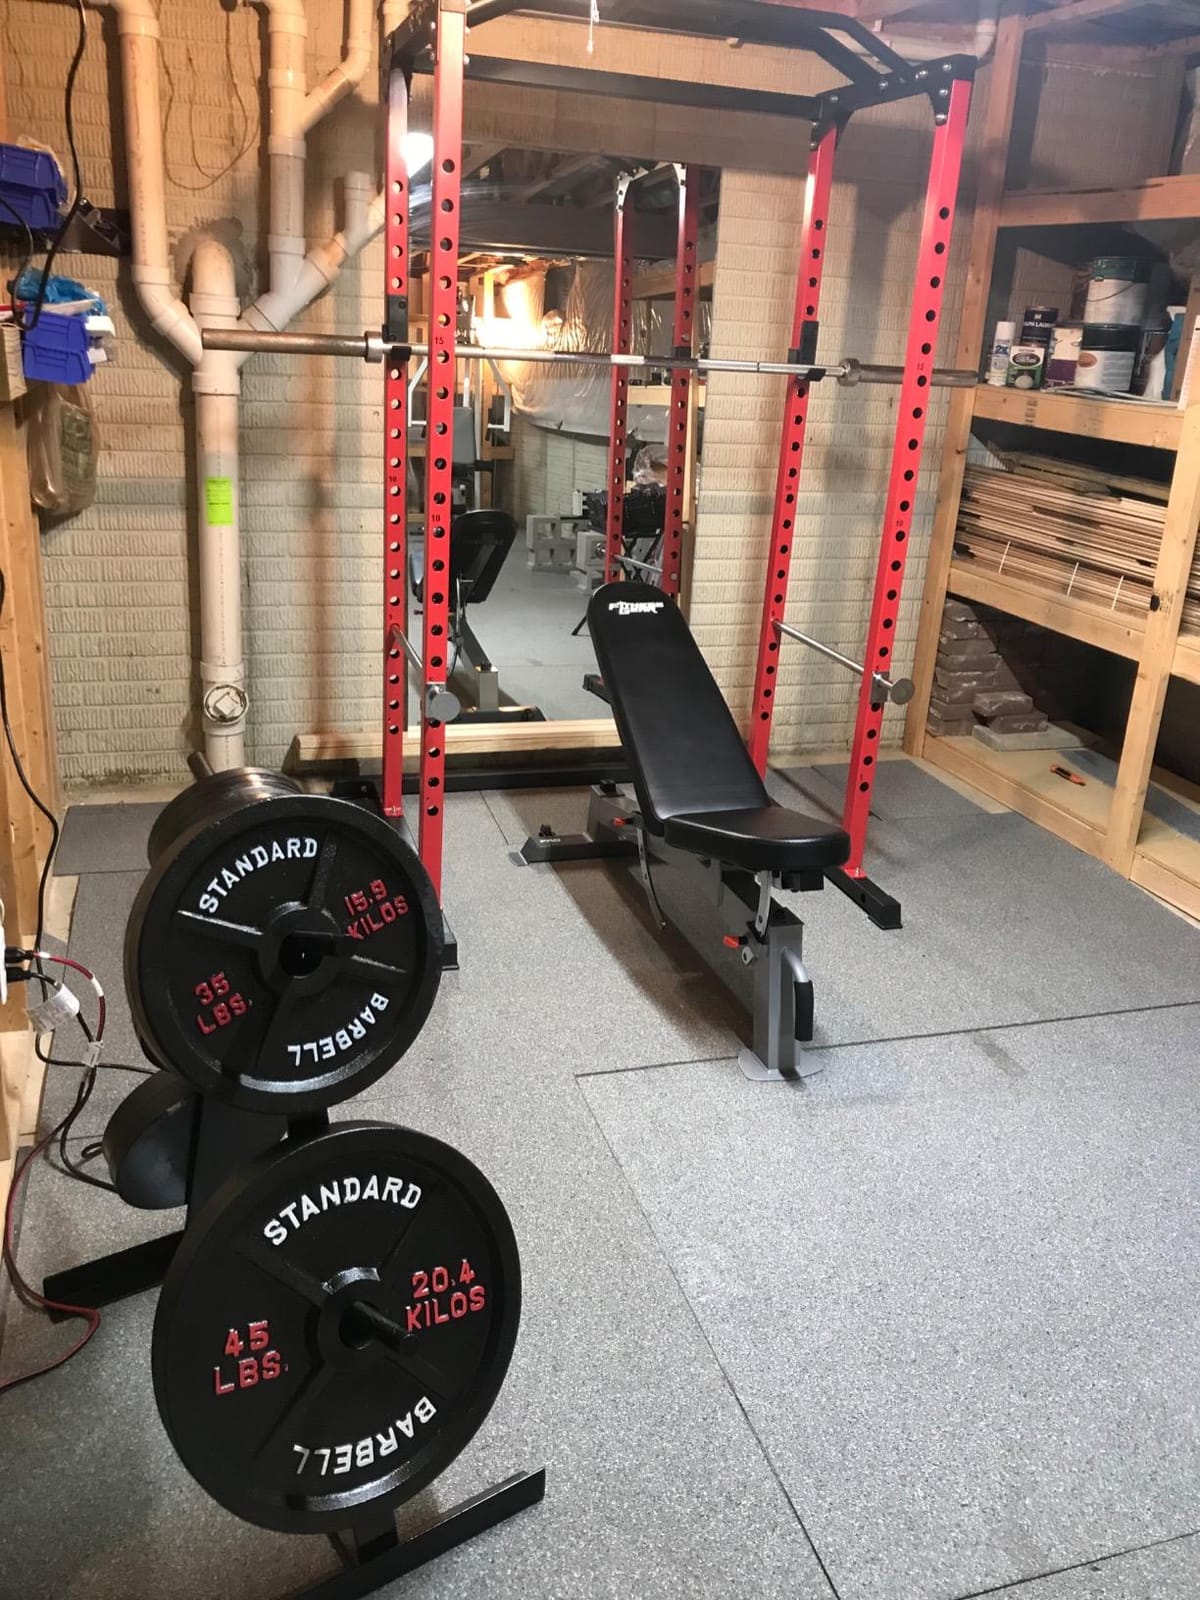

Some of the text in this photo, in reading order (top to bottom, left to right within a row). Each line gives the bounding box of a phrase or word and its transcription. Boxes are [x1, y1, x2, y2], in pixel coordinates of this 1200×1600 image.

[434, 336, 444, 345] 15
[994, 345, 1009, 355] 2X
[916, 362, 925, 371] 15
[389, 475, 398, 483] 10
[431, 514, 441, 523] 10
[896, 519, 904, 527] 10
[199, 837, 318, 912] STANDARD
[343, 879, 390, 916] 15.9
[346, 895, 410, 941] KILOS
[193, 971, 231, 1007] 35
[287, 991, 390, 1067] BARBELL
[263, 1174, 422, 1246] STANDARD
[411, 1258, 476, 1299] 20.4
[405, 1285, 487, 1334] KILOS
[223, 1319, 271, 1358] 45
[292, 1395, 439, 1476] BARBELL
